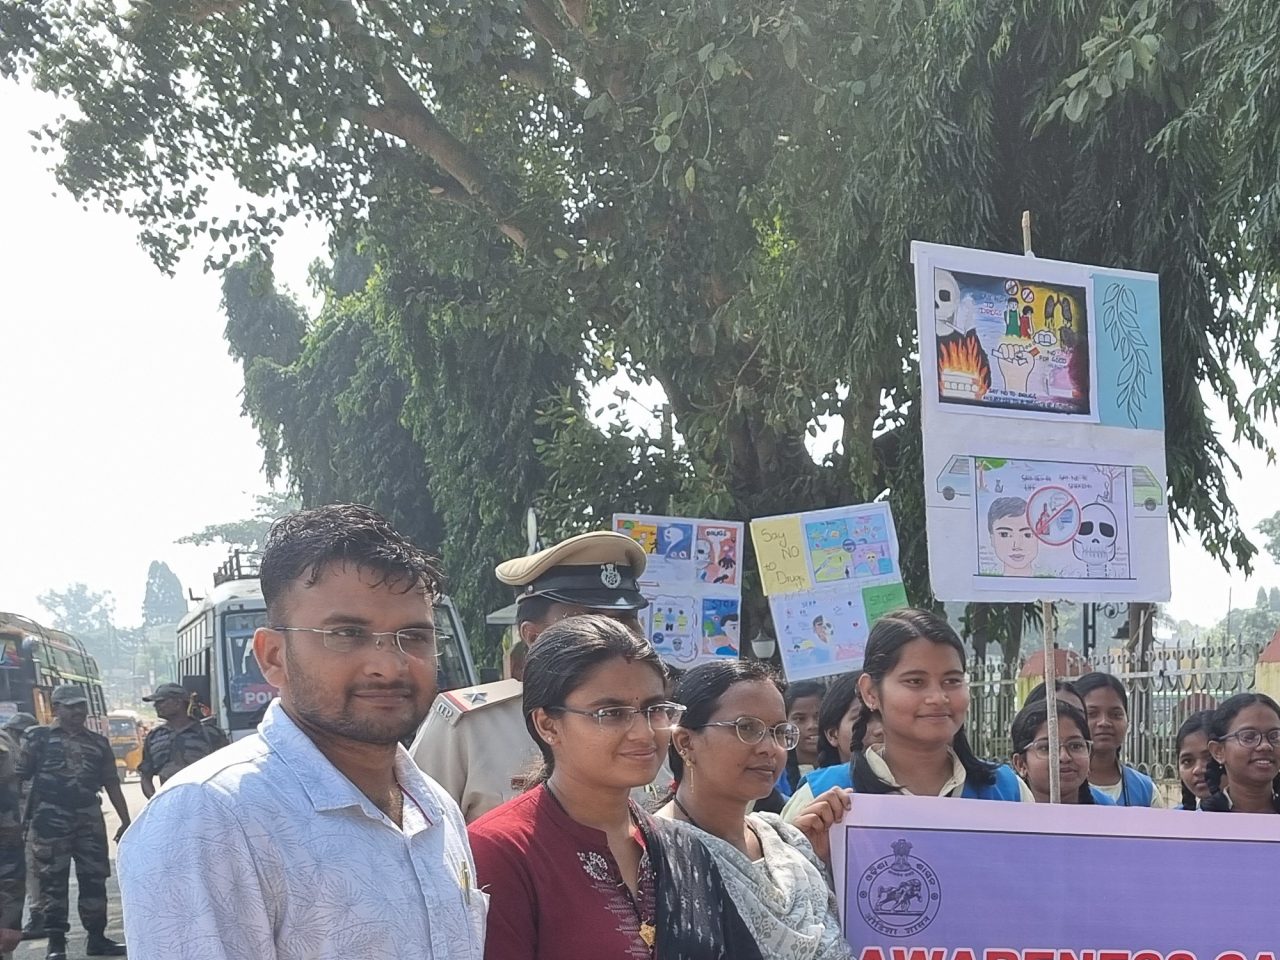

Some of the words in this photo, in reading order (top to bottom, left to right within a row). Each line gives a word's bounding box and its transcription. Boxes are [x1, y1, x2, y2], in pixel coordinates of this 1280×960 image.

[706, 530, 728, 538] DRUGS
[760, 528, 787, 548] Say
[781, 545, 800, 560] NO
